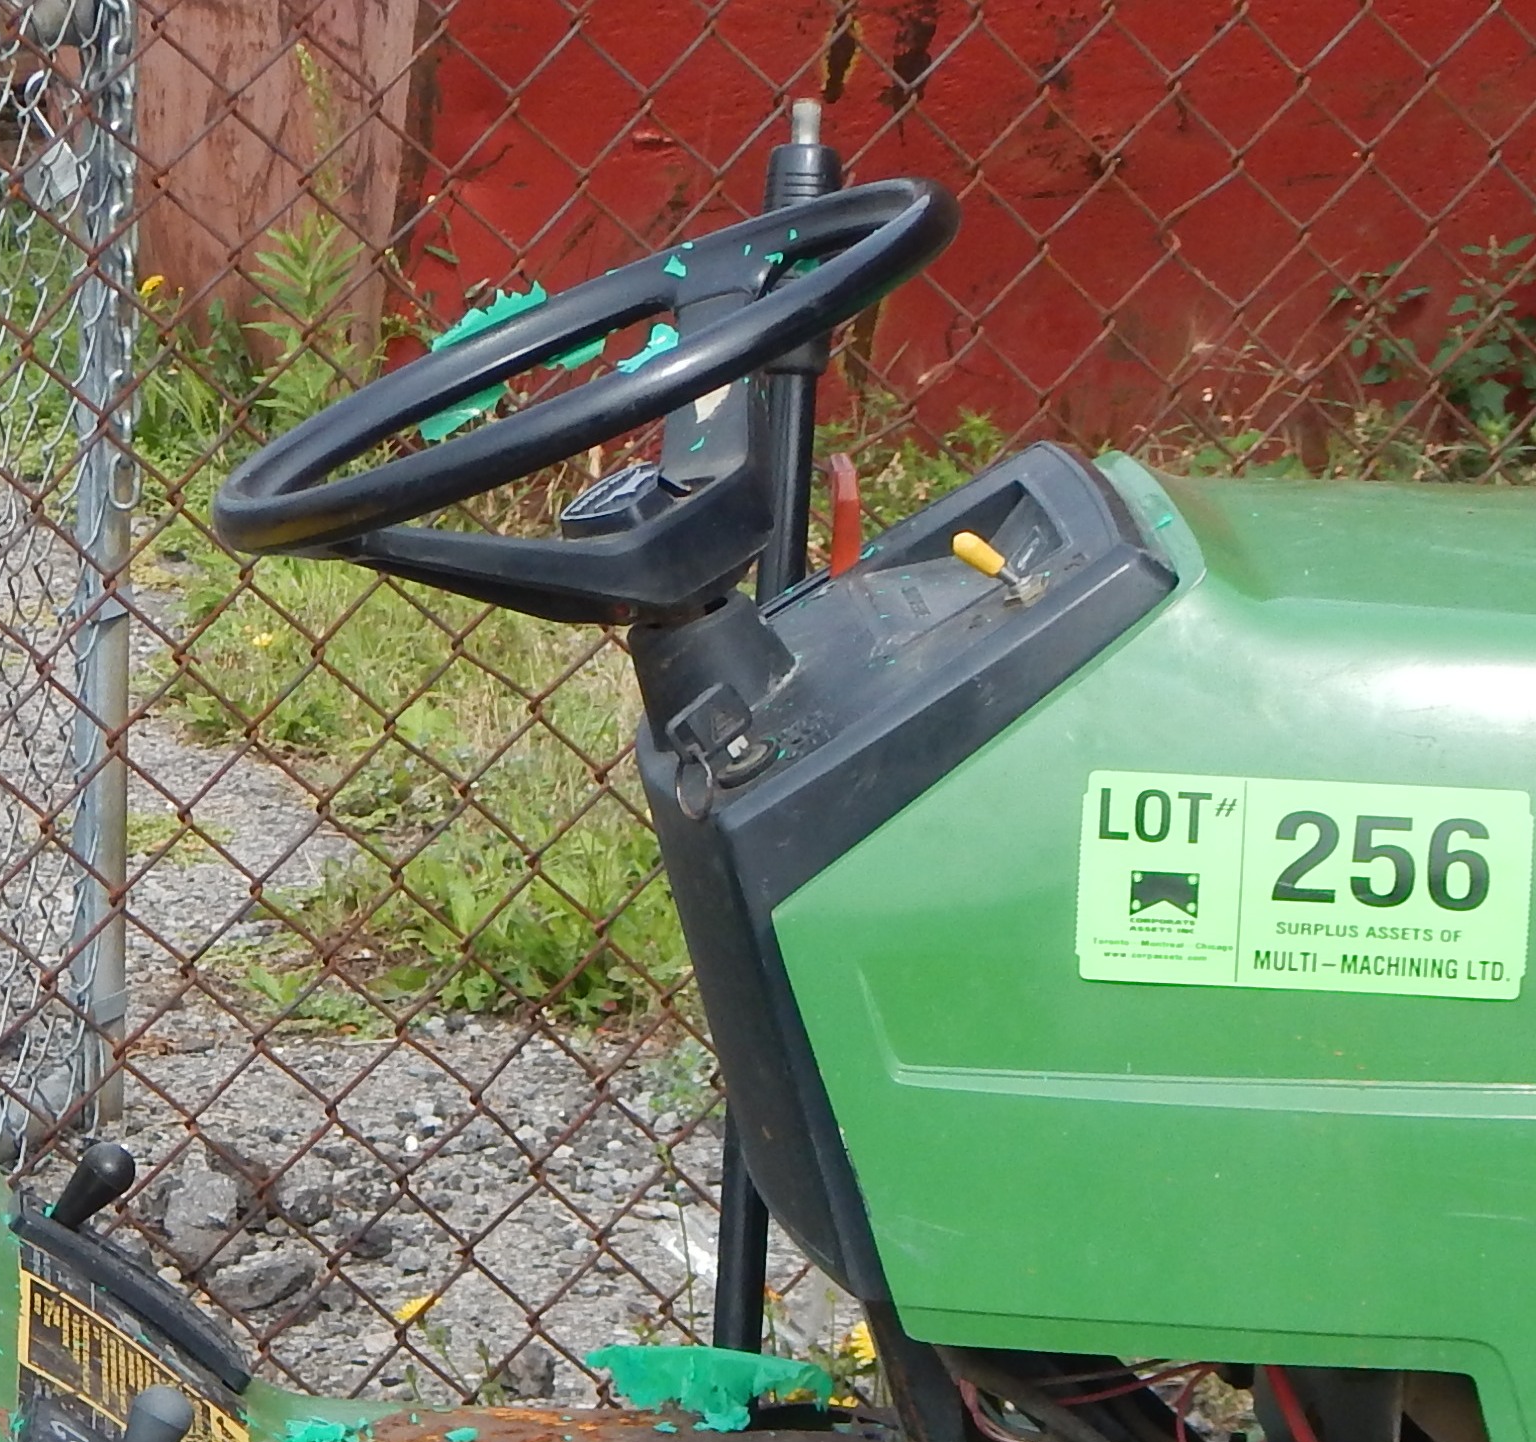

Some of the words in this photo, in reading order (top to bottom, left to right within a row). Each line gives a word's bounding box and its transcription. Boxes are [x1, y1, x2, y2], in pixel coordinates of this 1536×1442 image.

[1271, 811, 1491, 911] 256
[1275, 921, 1360, 938] SURPLUS
[1365, 924, 1434, 942] ASSETS
[1440, 929, 1463, 943] OF
[1195, 942, 1234, 953] Chicago
[1466, 958, 1511, 983] LTD.
